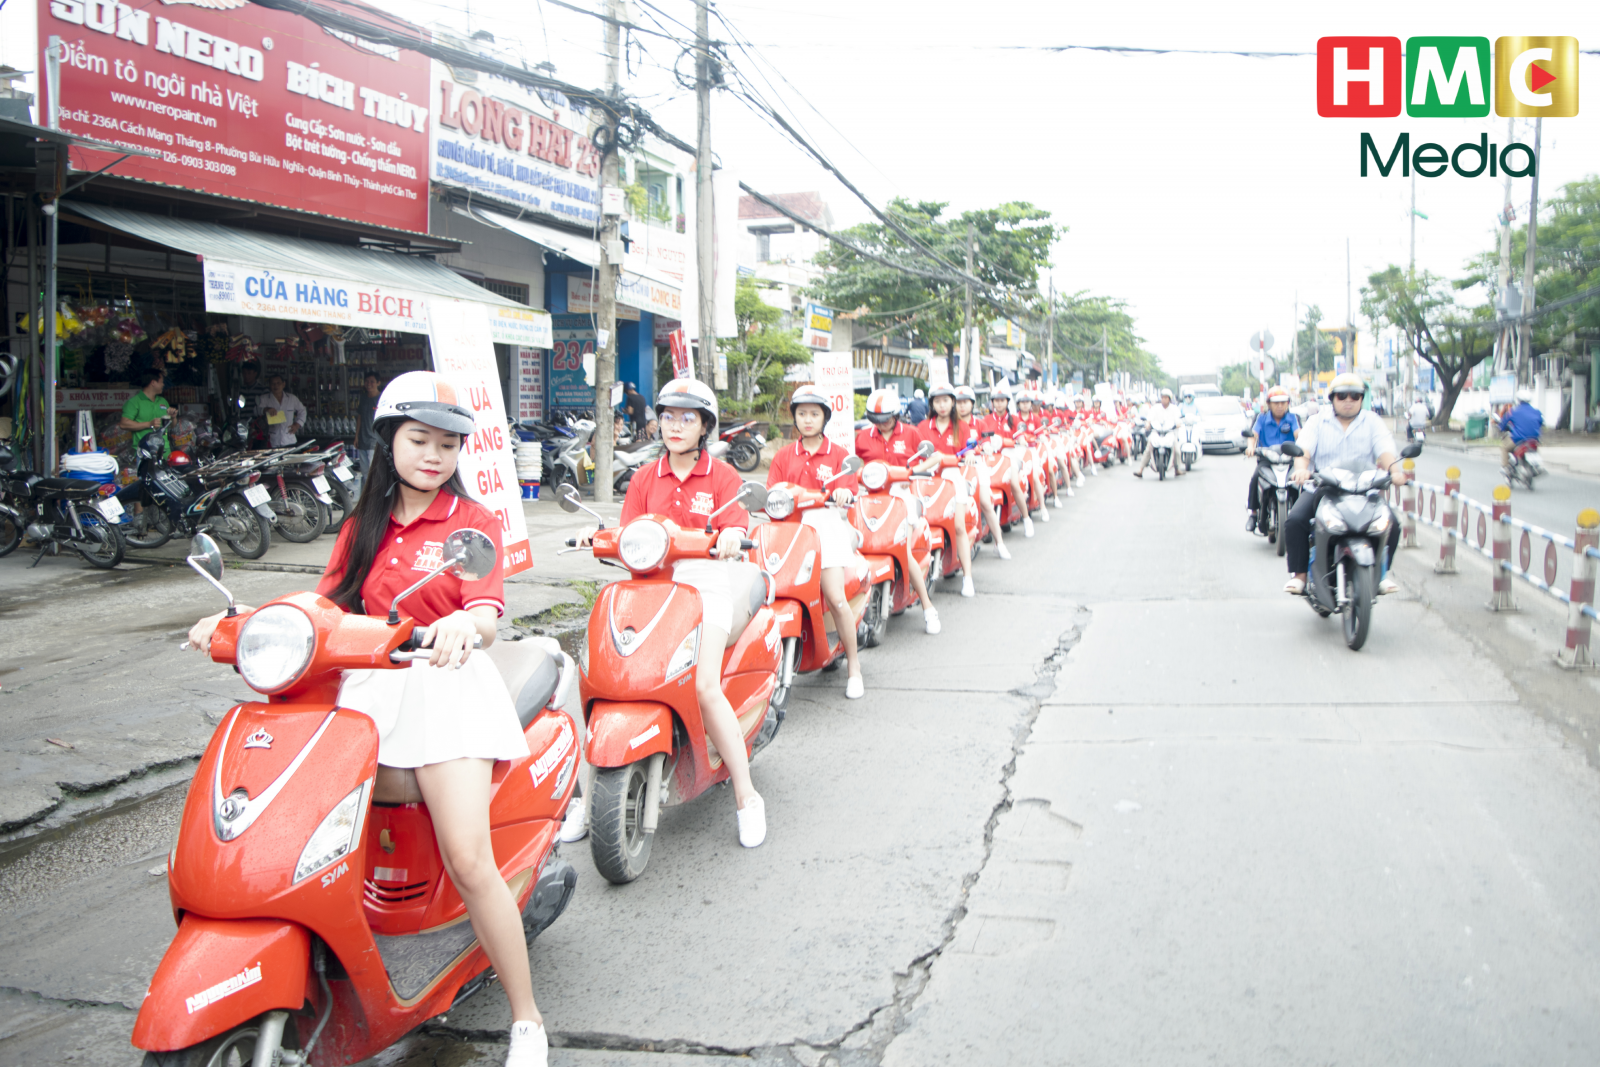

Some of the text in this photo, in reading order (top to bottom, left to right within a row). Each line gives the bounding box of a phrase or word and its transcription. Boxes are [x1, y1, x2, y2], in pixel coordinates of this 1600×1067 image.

[155, 16, 264, 82] NERO
[114, 59, 137, 82] tô
[145, 73, 185, 97] ngôi
[191, 81, 222, 107] nhà
[226, 89, 258, 118] Việt
[286, 62, 355, 110] BÍCH
[359, 86, 428, 133] THỦY
[111, 91, 217, 128] www.neropaint.vn
[439, 80, 525, 151] LONG
[528, 109, 574, 168] HẢI
[92, 114, 119, 130] 236A
[120, 120, 145, 137] Cách
[147, 127, 173, 146] Mạng
[175, 133, 204, 152] Tháng
[285, 112, 308, 134] Cung
[328, 124, 345, 141] Sơn
[371, 137, 386, 153] Sơn
[204, 161, 219, 173] 303
[220, 163, 236, 176] 098
[285, 132, 303, 151] Bột
[351, 151, 377, 172] Chống
[244, 270, 413, 318] CỬA HÀNG BÍCH
[256, 302, 277, 312] 236A
[651, 287, 670, 307] LONG
[69, 390, 130, 402] KHÓA VIỆT TIỆP
[464, 380, 493, 412] UÀ
[476, 462, 504, 495] GIÁ
[494, 508, 513, 538] RỊ
[510, 549, 527, 567] 1267
[677, 673, 692, 687] SYM
[321, 861, 349, 888] SYM
